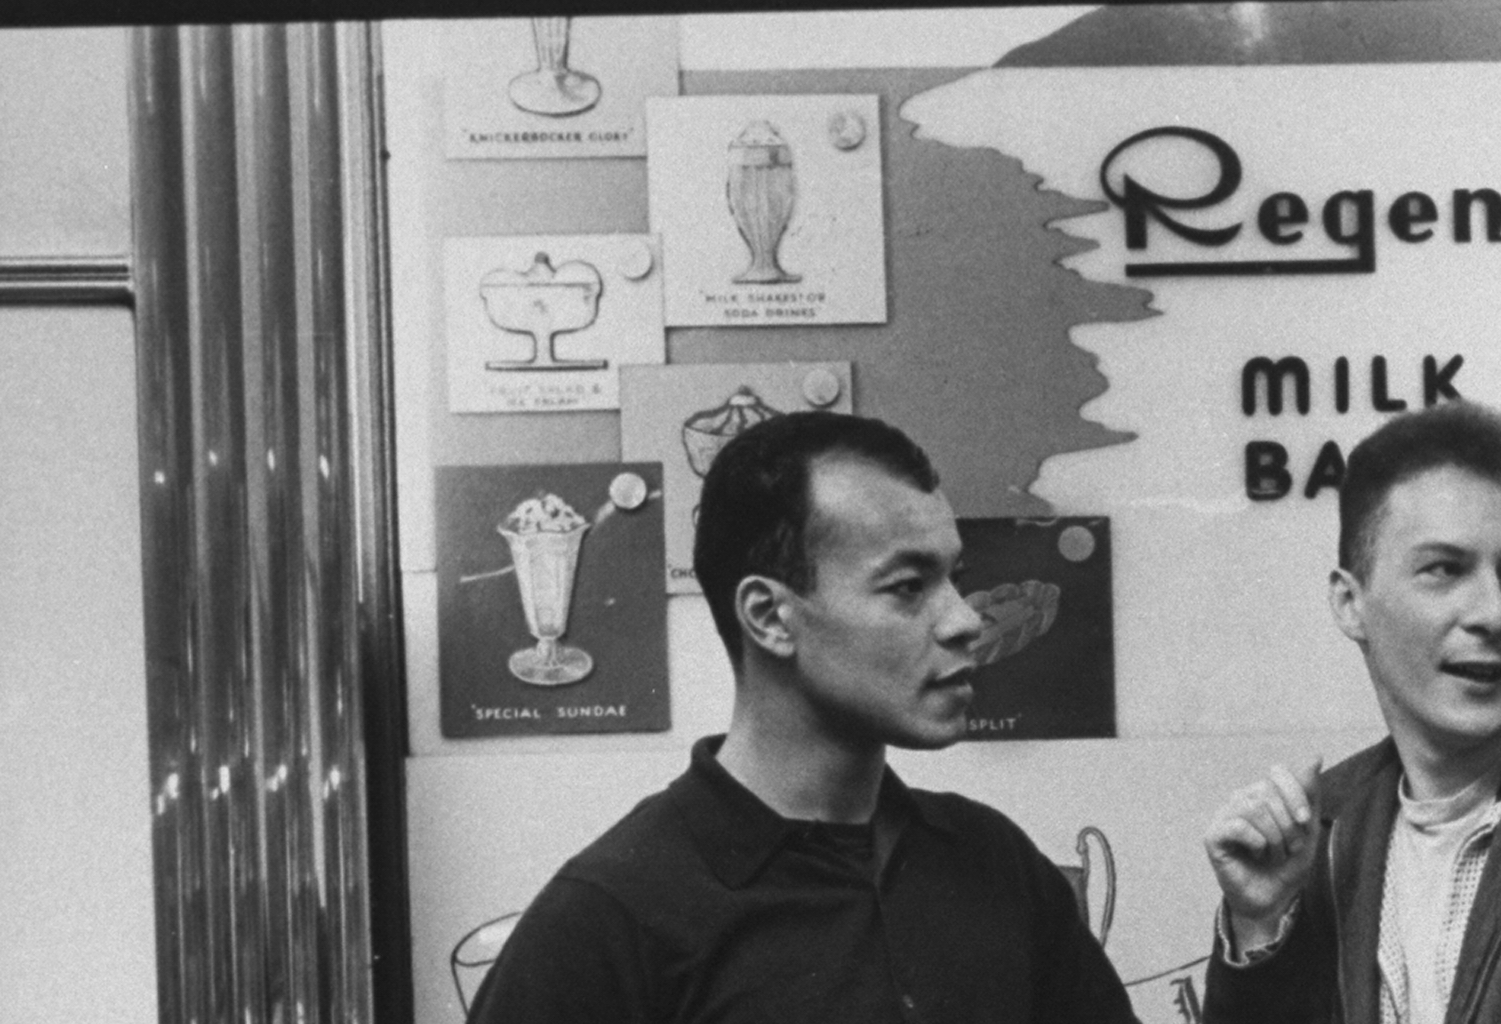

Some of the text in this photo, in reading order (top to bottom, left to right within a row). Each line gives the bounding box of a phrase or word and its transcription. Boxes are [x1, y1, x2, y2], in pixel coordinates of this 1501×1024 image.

[1242, 354, 1464, 417] MILK
[1246, 440, 1348, 501] BA
[555, 704, 627, 718] SUNDAE
